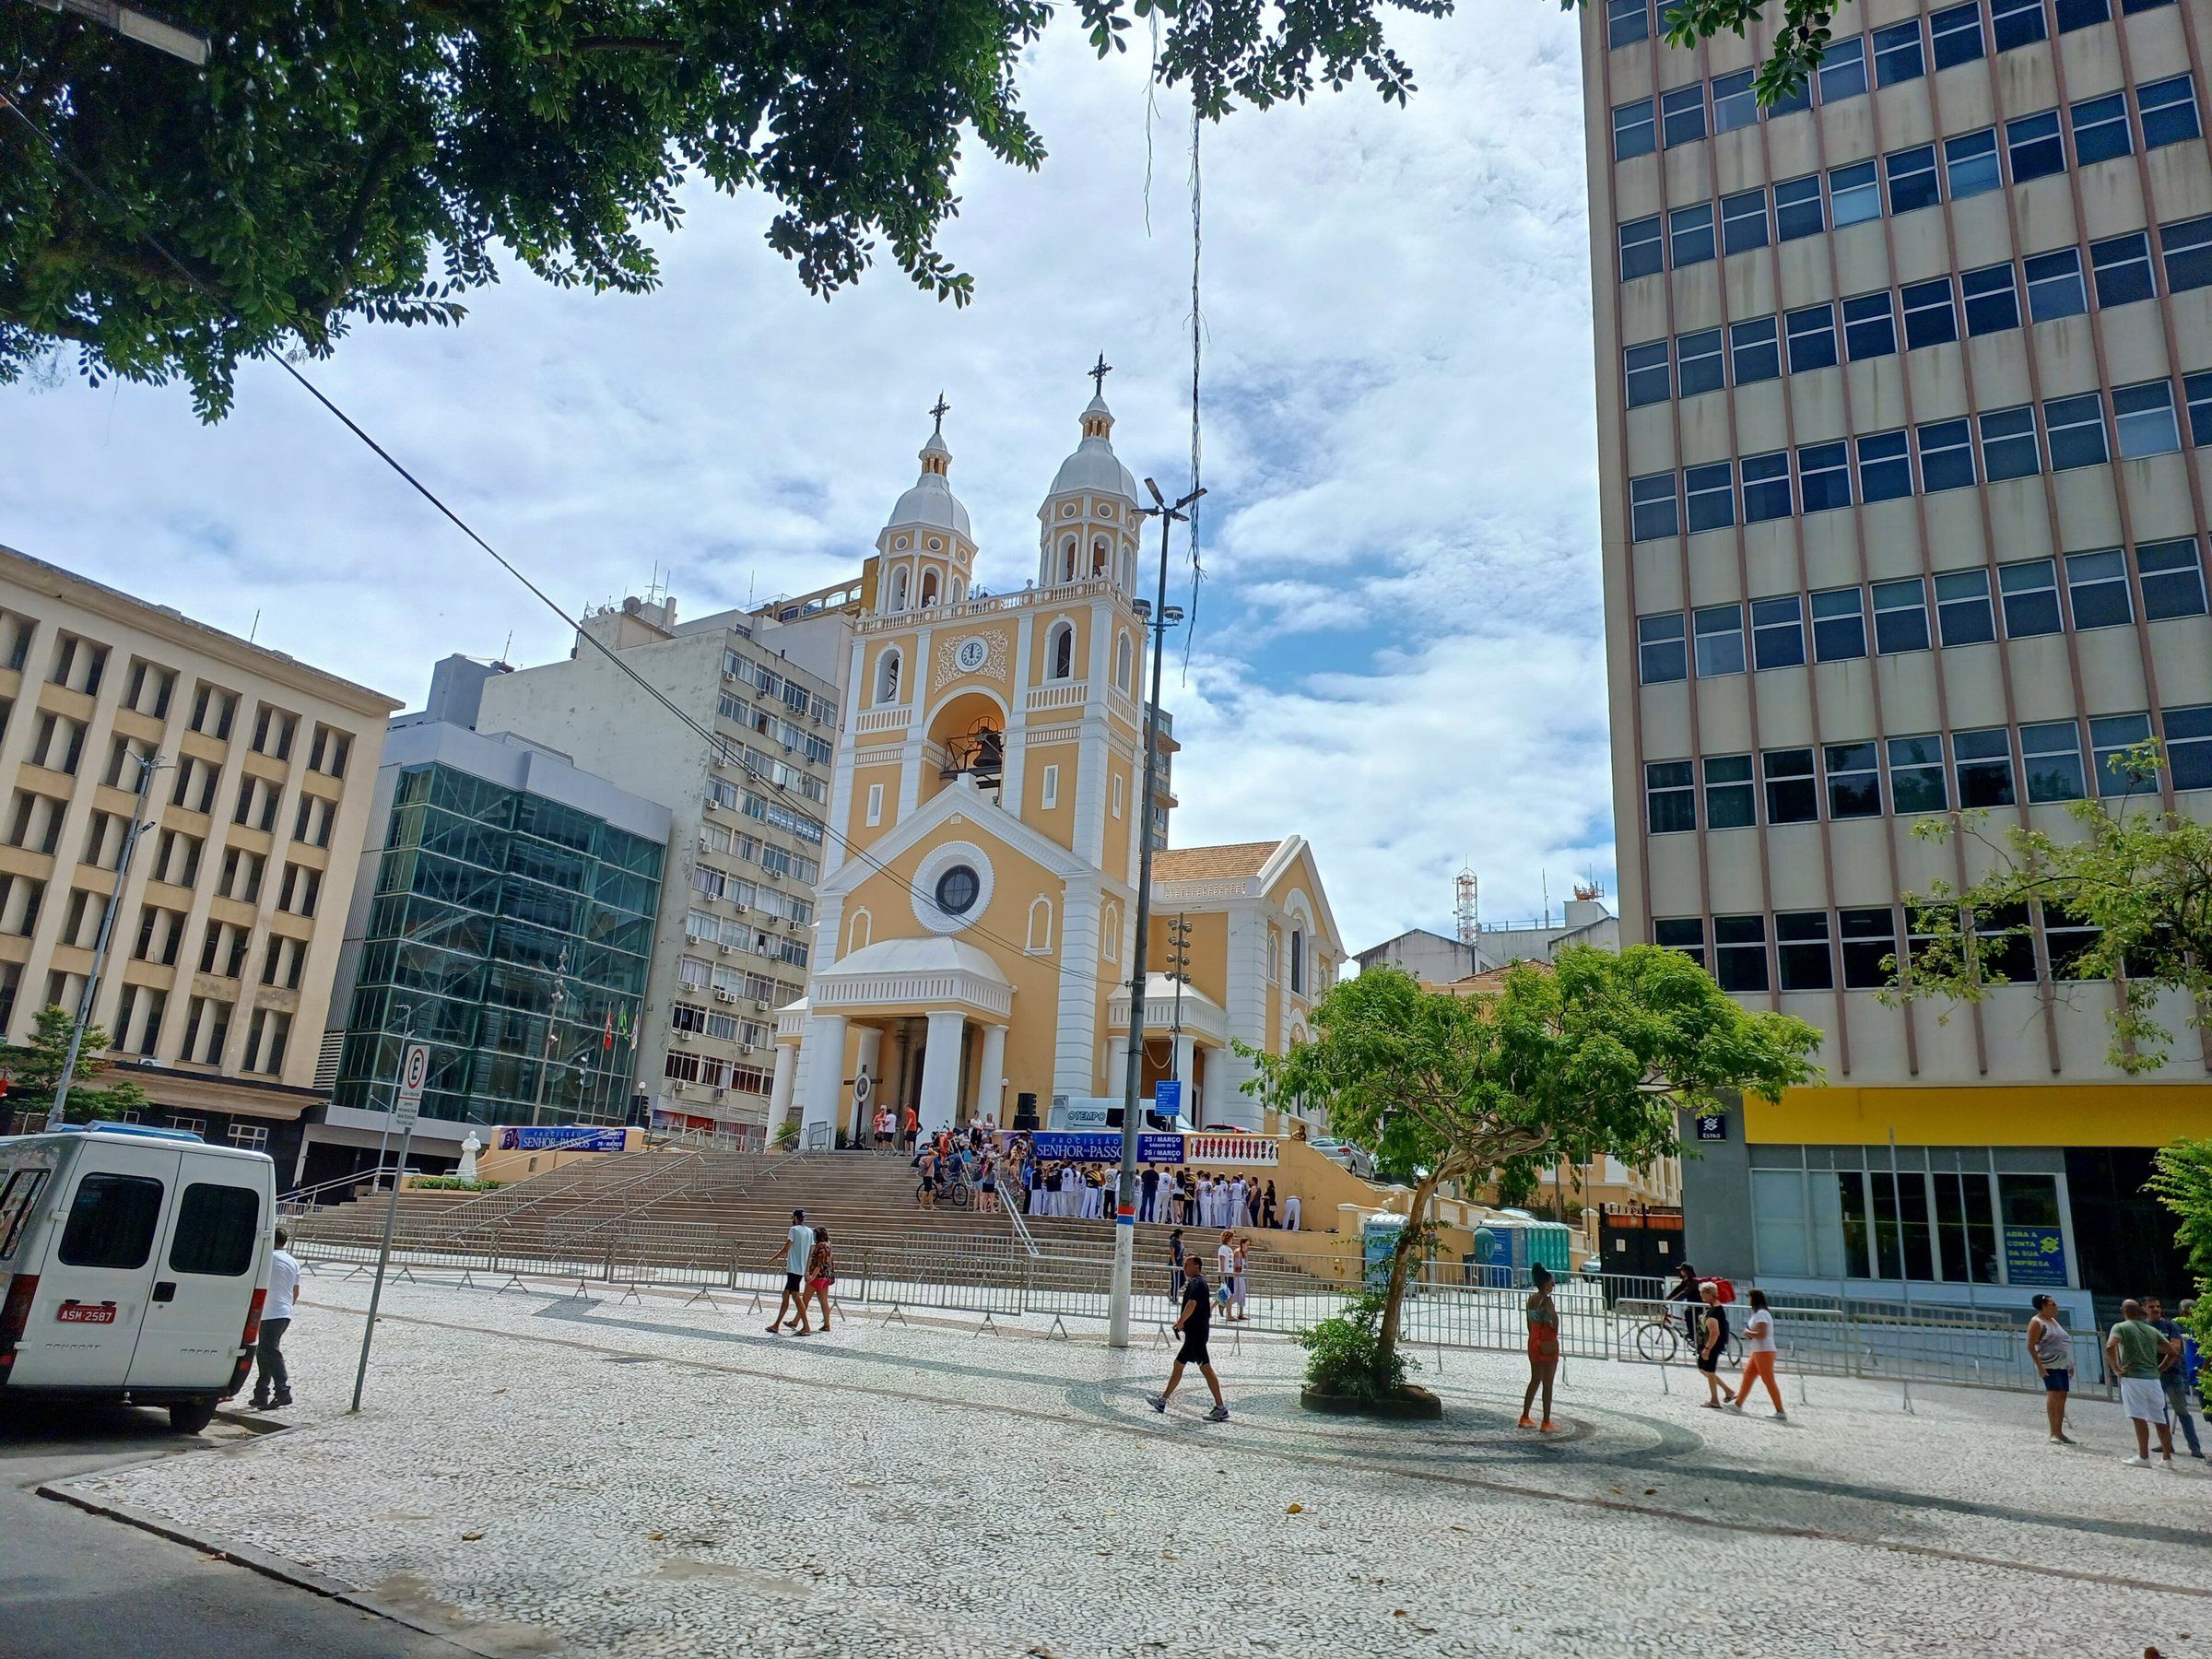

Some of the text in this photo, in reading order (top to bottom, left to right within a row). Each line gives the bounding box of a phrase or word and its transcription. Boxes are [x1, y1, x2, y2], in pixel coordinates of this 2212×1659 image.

[412, 1057, 419, 1079] E
[523, 1136, 556, 1148] SENHOR
[1051, 1136, 1119, 1145] PROCISSÃO
[1036, 1144, 1084, 1157] SENHOR
